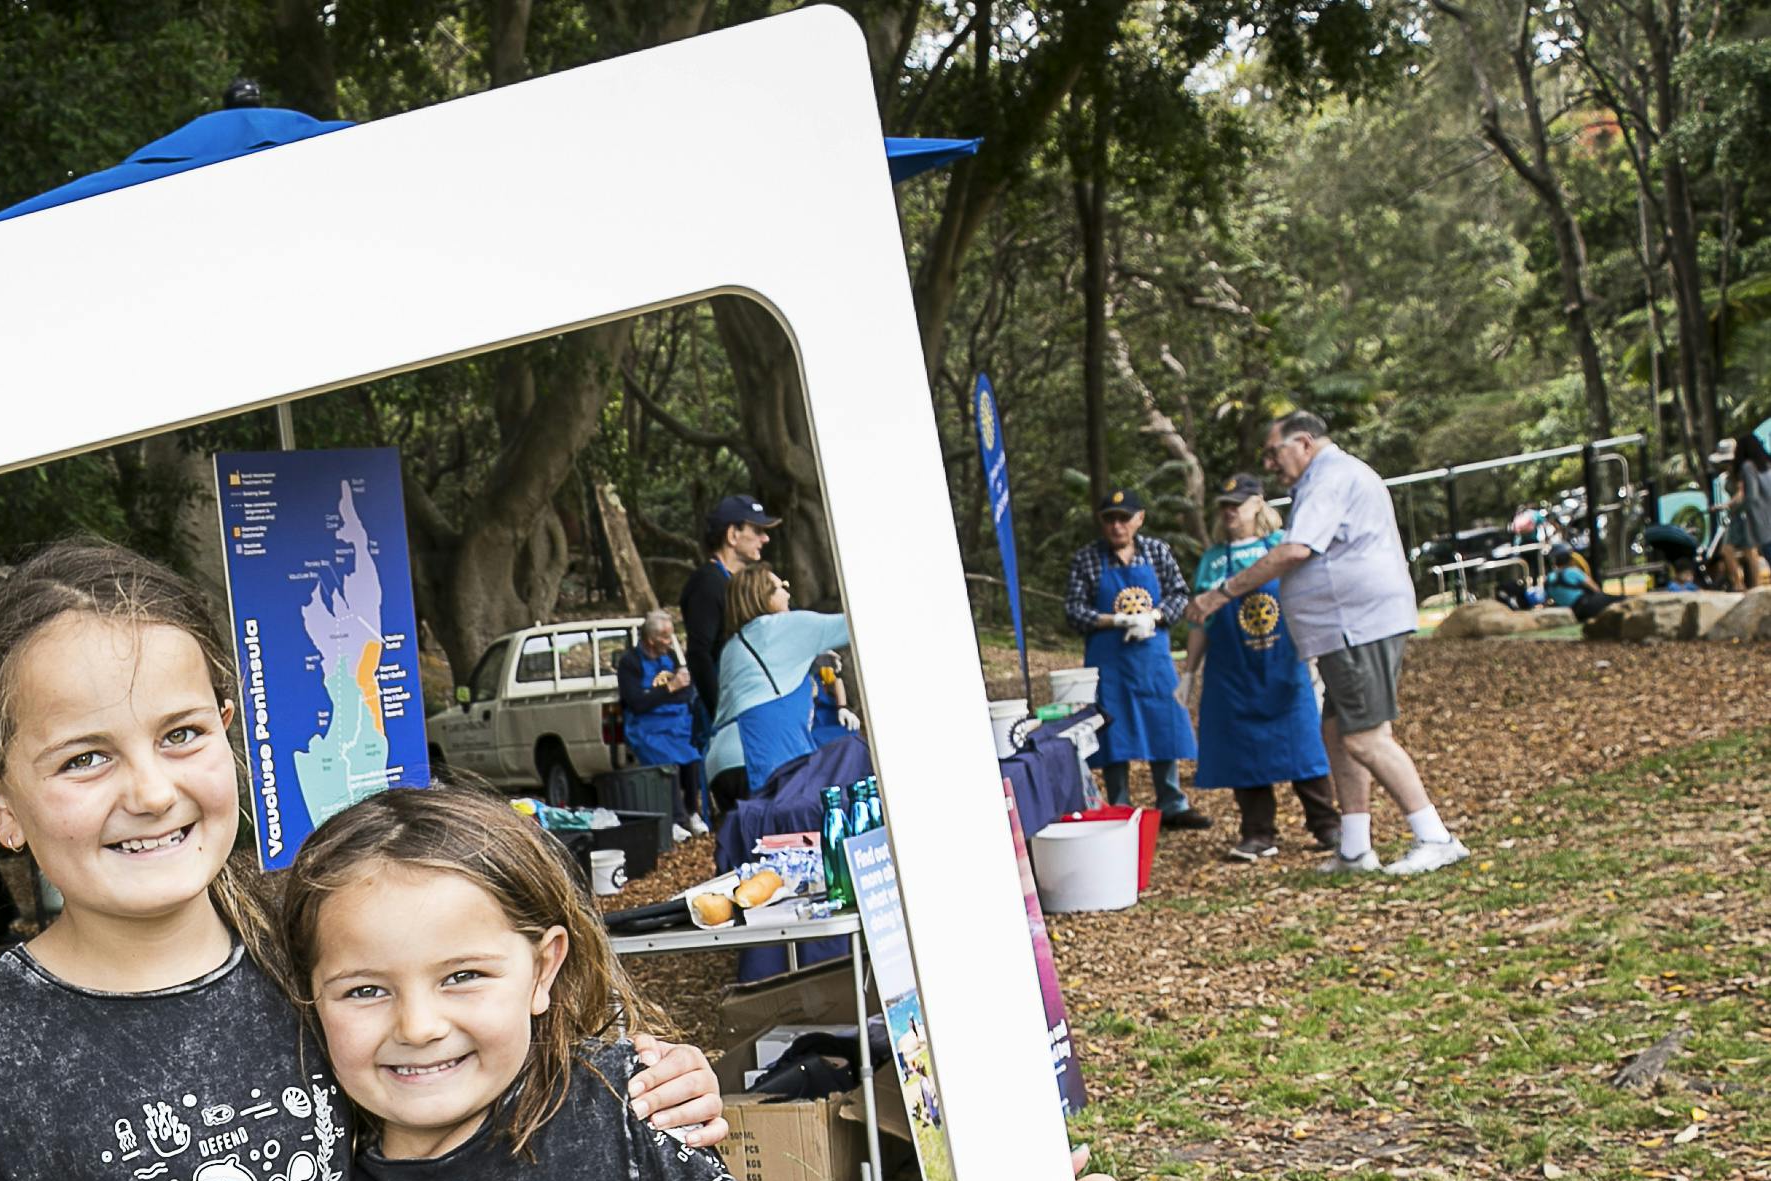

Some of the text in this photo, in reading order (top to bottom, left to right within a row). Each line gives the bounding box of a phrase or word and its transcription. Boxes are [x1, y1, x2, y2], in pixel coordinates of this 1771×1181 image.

[244, 619, 283, 858] Vaucluse Peninsula
[198, 1126, 249, 1158] DEFEND
